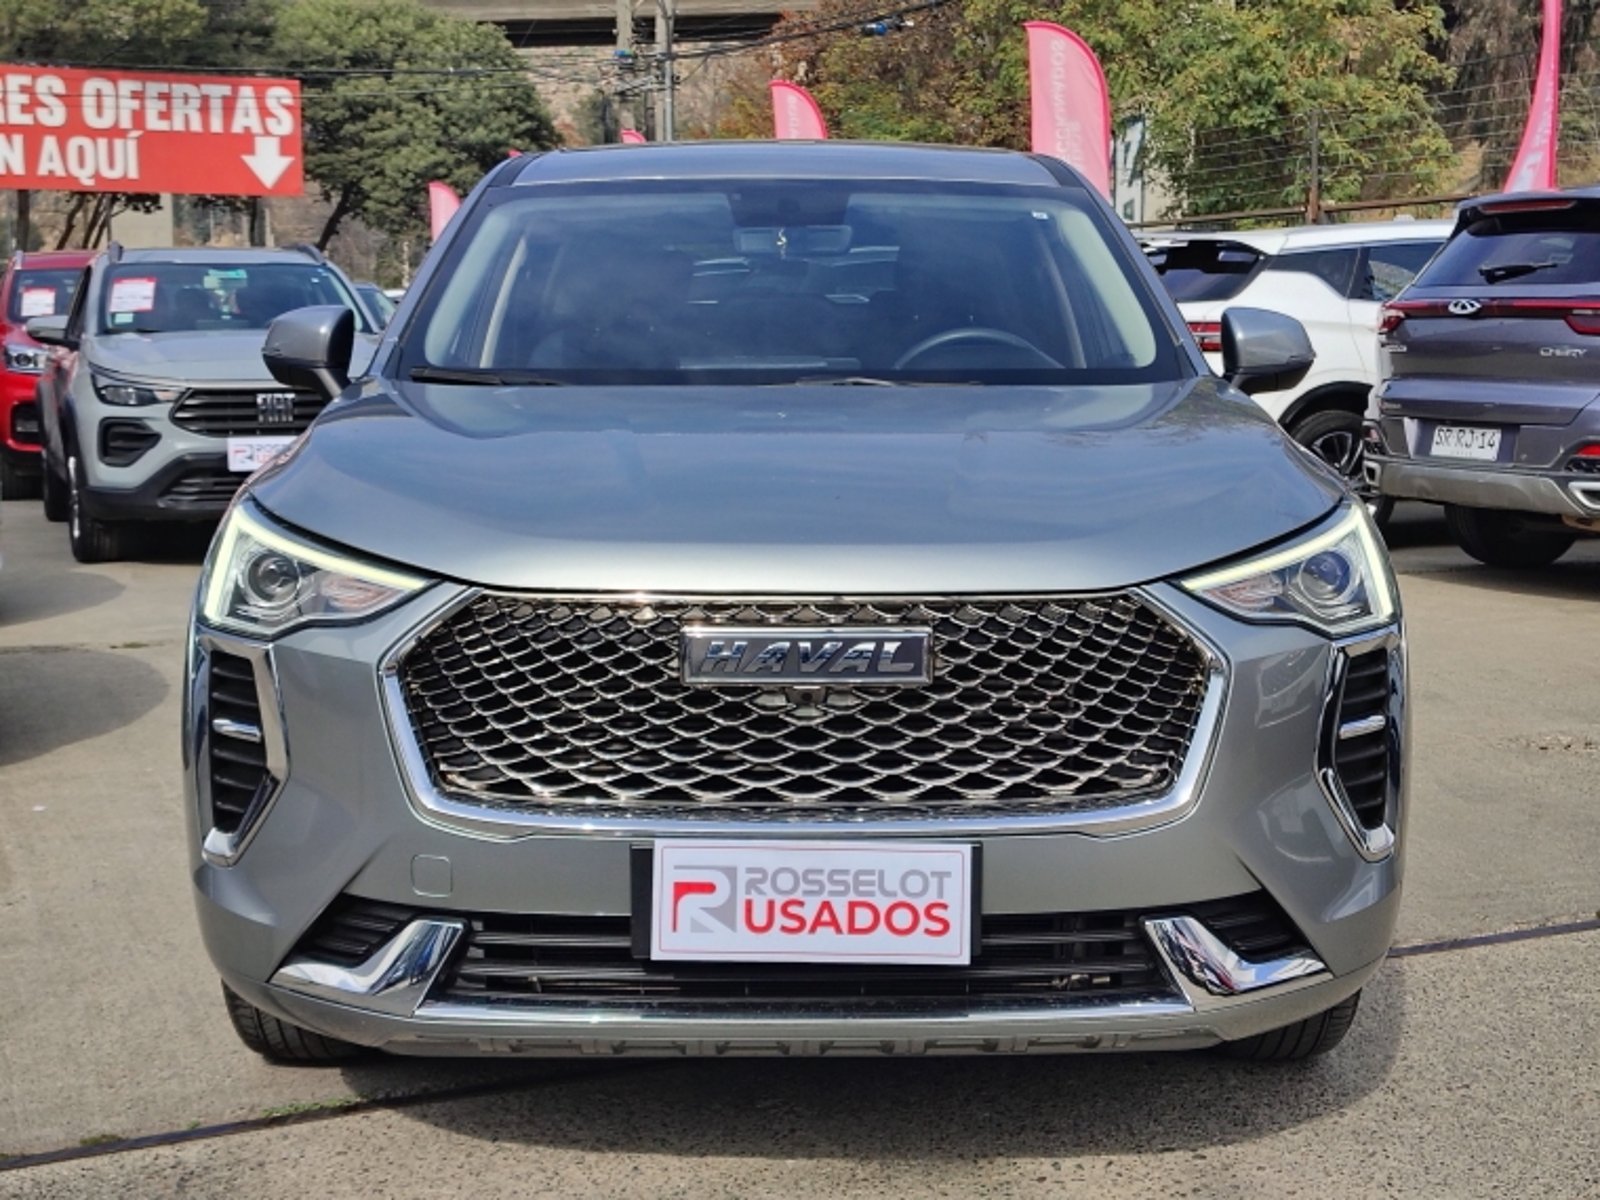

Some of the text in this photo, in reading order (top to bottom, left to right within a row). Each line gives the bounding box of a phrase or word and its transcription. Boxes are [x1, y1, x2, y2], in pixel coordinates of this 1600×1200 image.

[0, 73, 295, 136] ES OFERTAS
[37, 130, 144, 186] AQUÍ
[700, 641, 915, 673] HAVAL
[744, 866, 952, 899] ROSSELOT
[744, 898, 951, 938] USADOS
